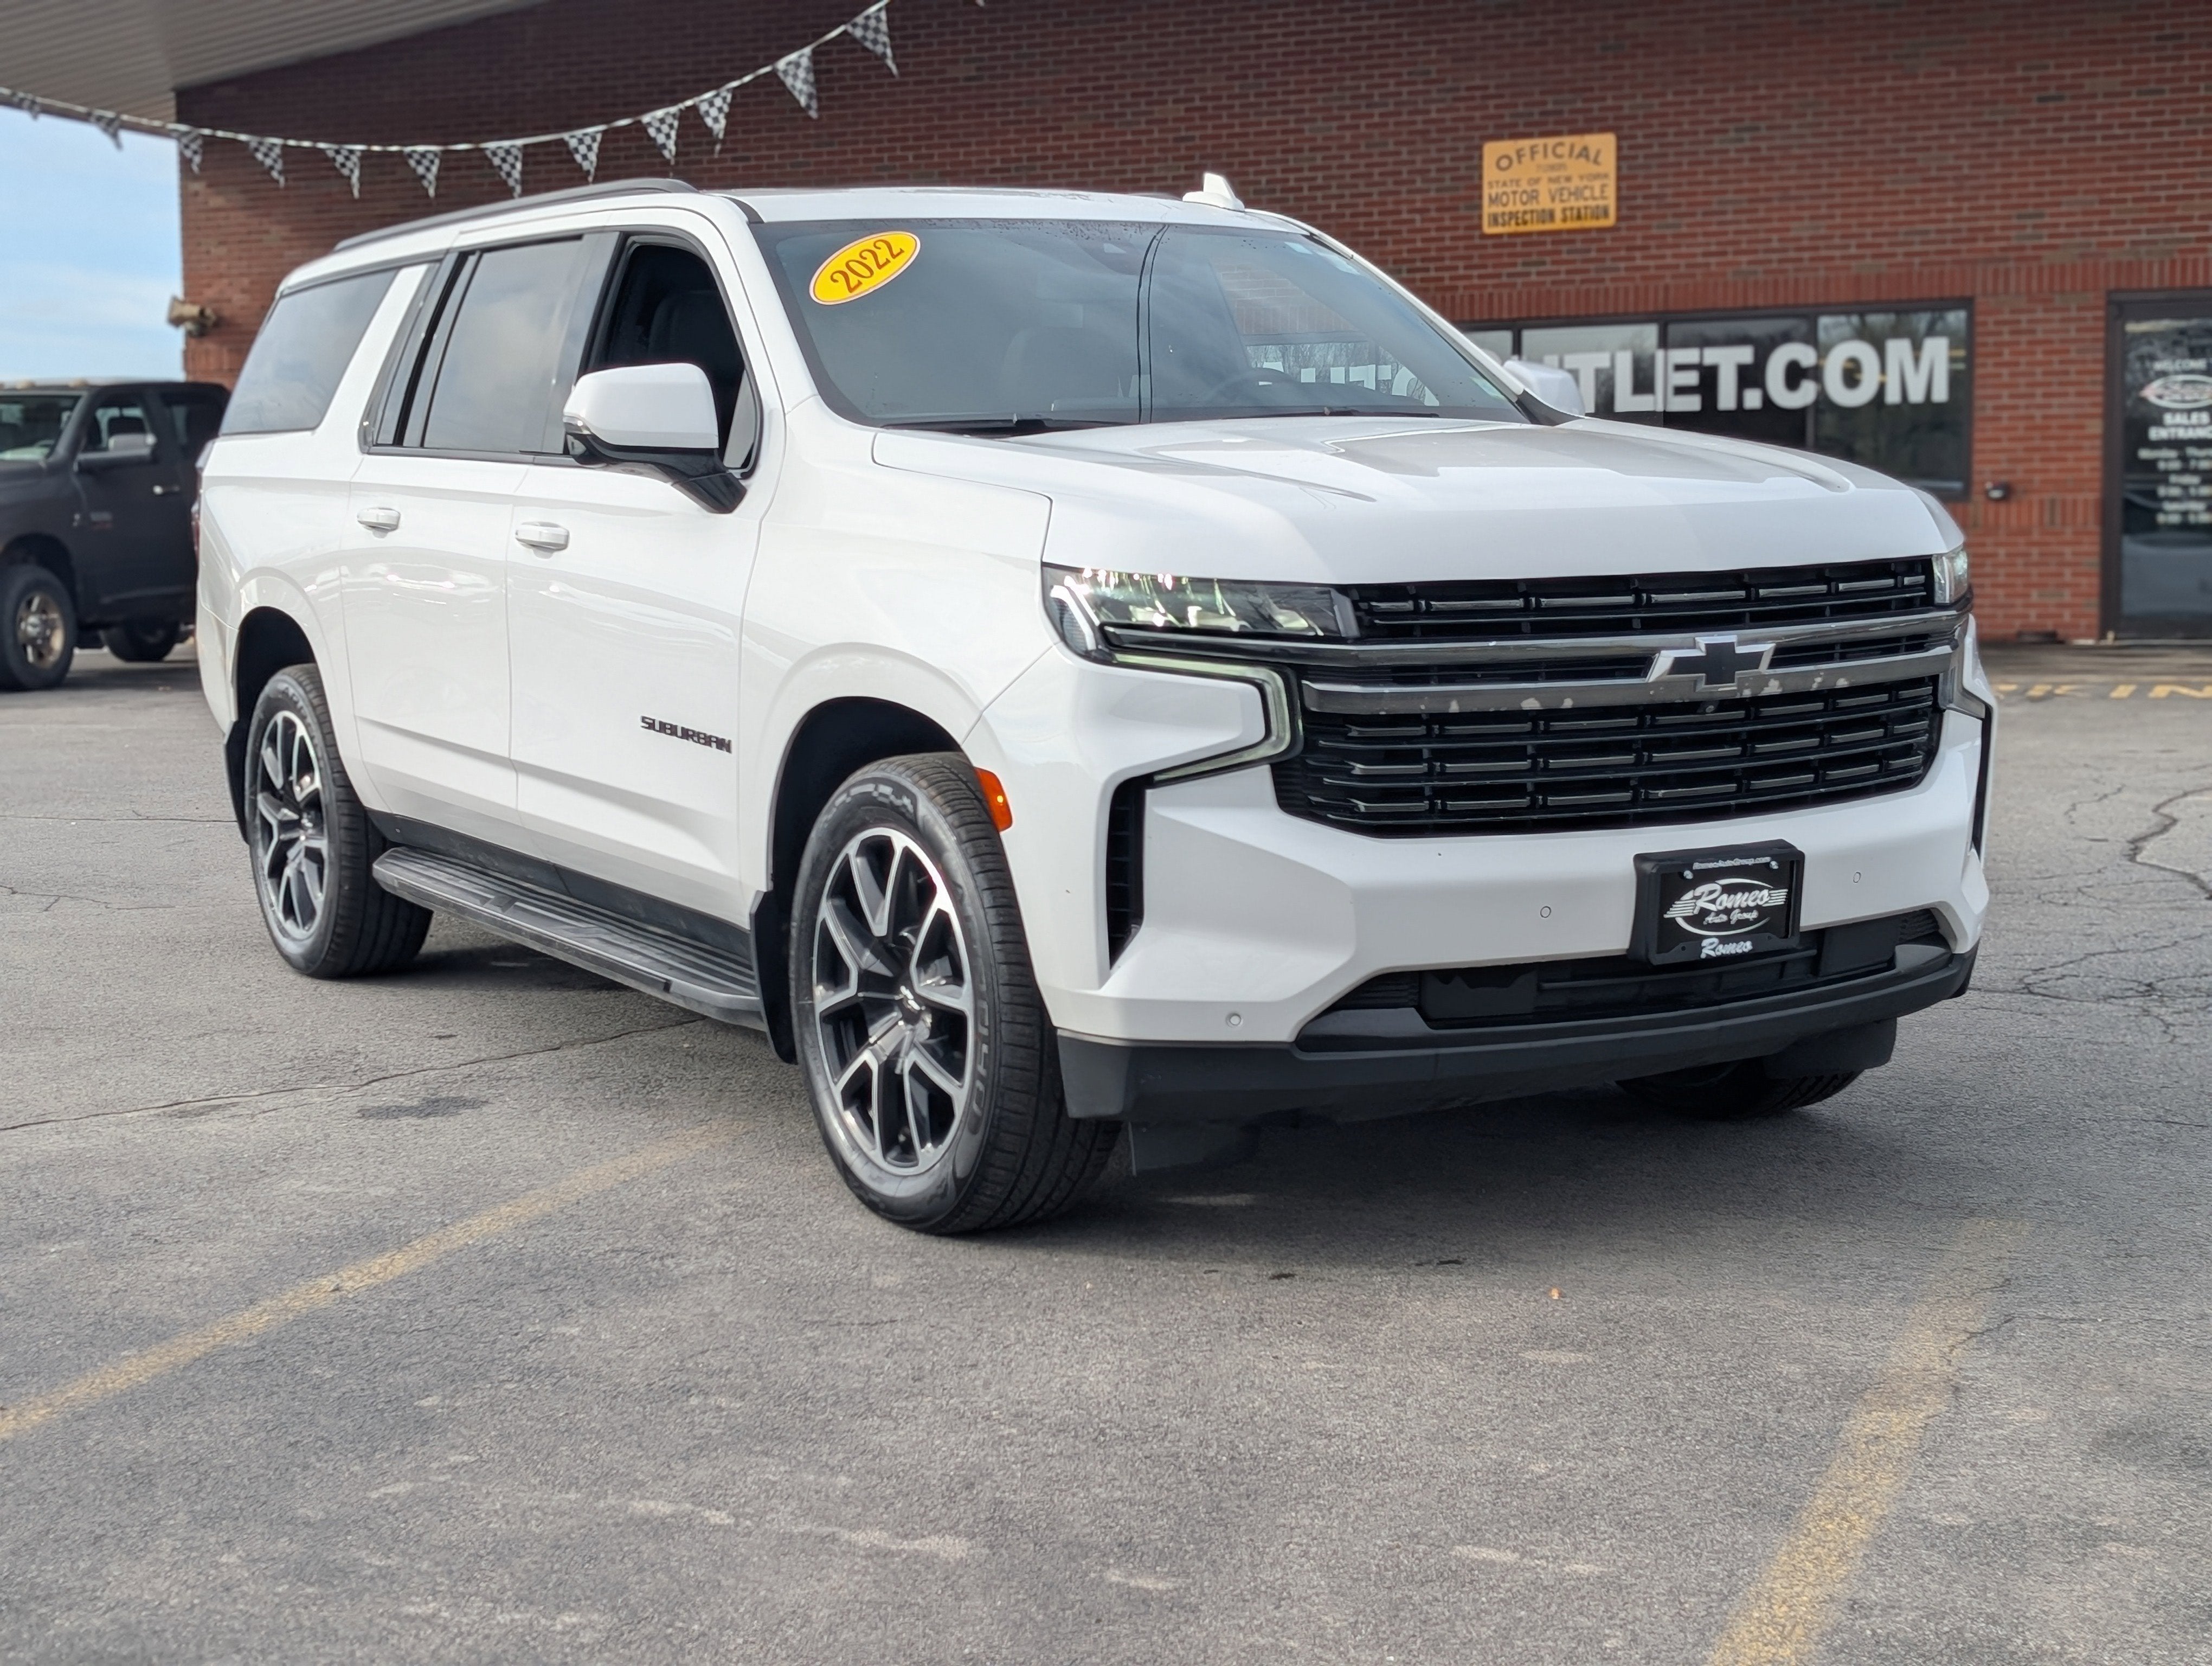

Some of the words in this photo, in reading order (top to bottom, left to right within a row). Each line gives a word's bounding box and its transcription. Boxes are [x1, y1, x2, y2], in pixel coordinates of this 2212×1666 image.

[1495, 142, 1602, 171] OFFICIAL
[1487, 178, 1521, 190] STATE
[1527, 177, 1541, 186] OF
[1488, 189, 1540, 208] MOTOR
[1547, 183, 1608, 203] VEHICLE
[1488, 208, 1555, 228] INSPECTION
[1561, 204, 1610, 223] STATION
[830, 239, 905, 293] 2022
[2163, 411, 2210, 427] SALES
[640, 715, 732, 754] SUBURBAN
[1693, 883, 1770, 914] Romeo
[1700, 937, 1753, 959] Romeo
